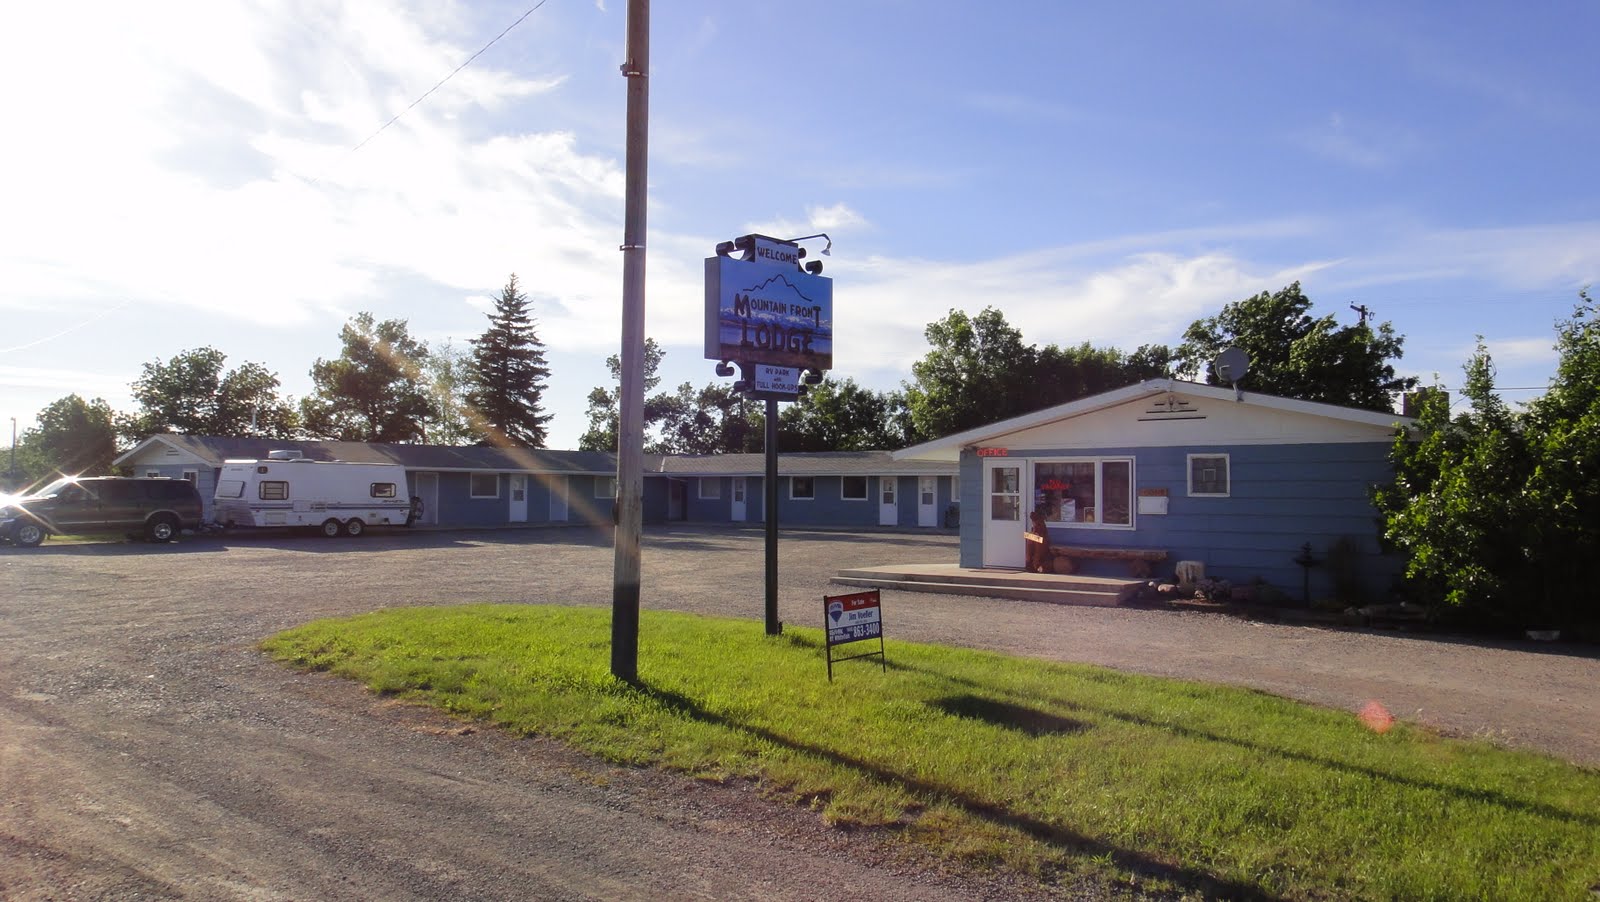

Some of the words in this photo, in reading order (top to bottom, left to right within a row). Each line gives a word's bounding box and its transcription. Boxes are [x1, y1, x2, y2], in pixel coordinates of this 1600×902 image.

[757, 247, 797, 264] WELCOME
[735, 293, 787, 318] MOUNTAIN
[790, 305, 821, 328] FRONT
[741, 320, 814, 354] LODGE
[765, 367, 773, 375] RV
[775, 368, 790, 376] PARK
[976, 448, 1008, 457] OFFICE
[848, 612, 857, 621] Jim
